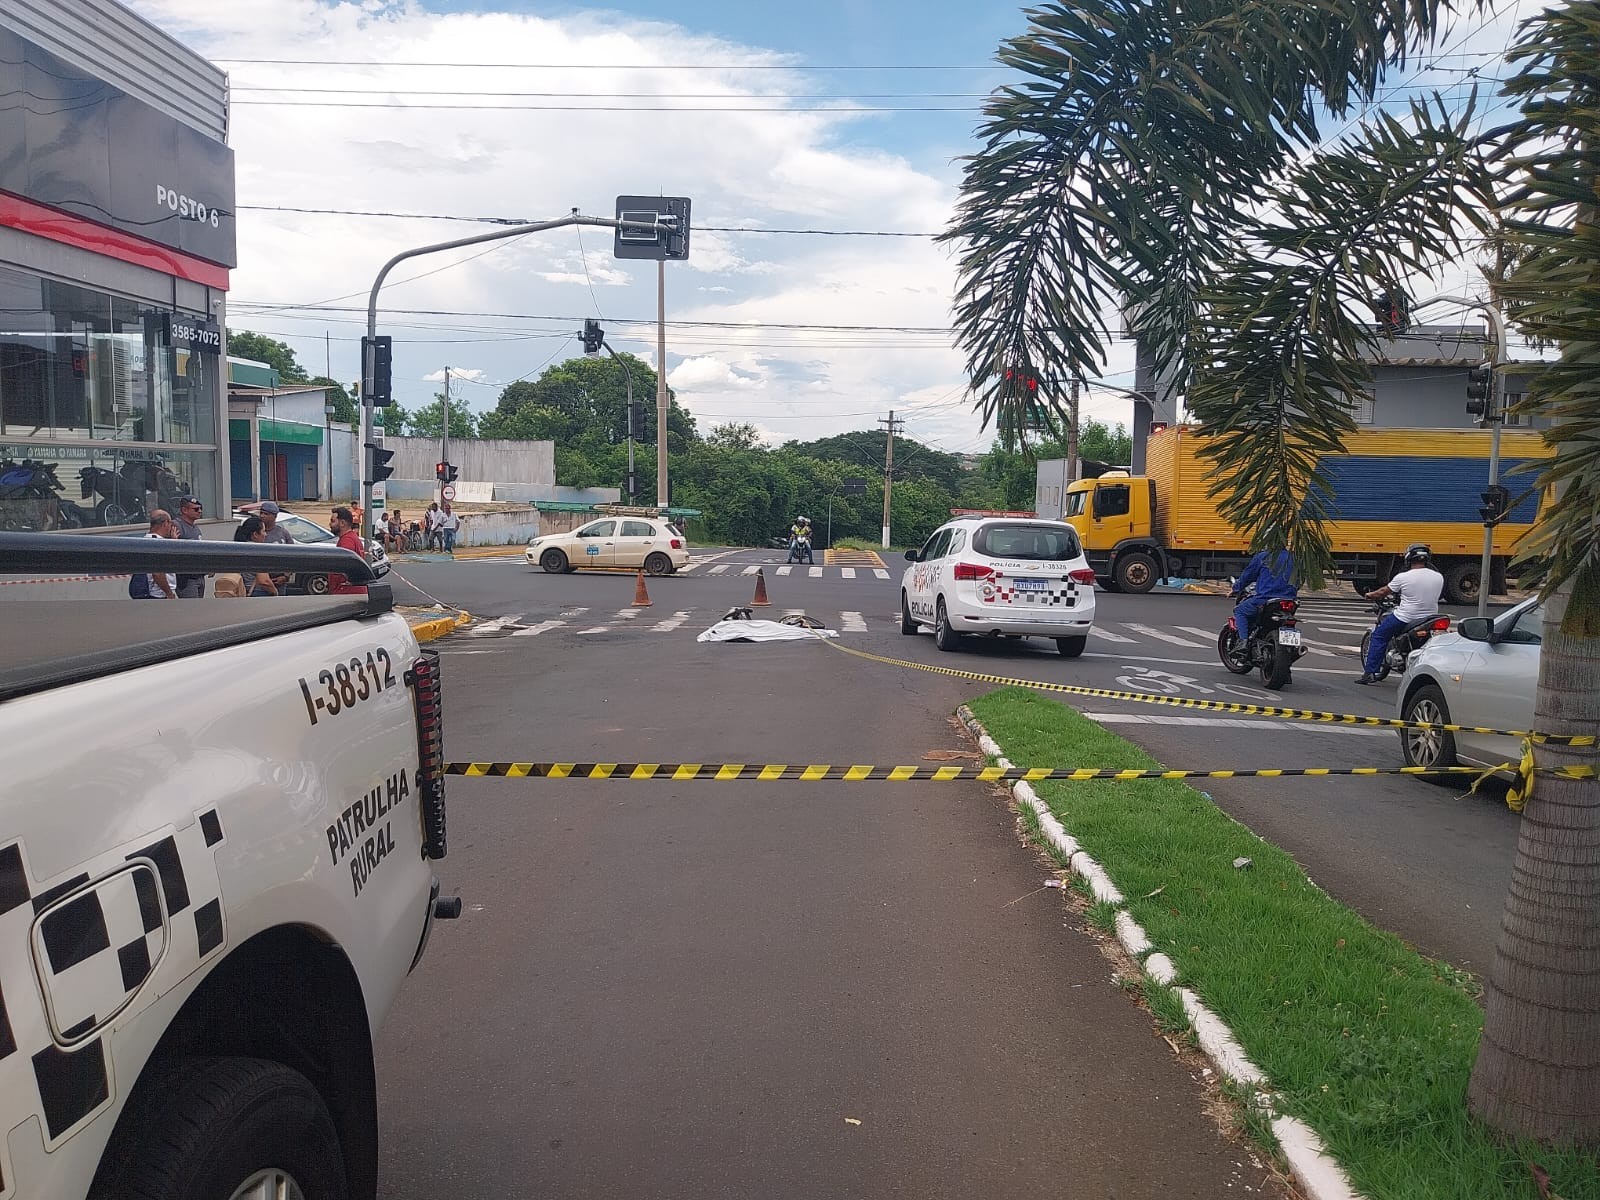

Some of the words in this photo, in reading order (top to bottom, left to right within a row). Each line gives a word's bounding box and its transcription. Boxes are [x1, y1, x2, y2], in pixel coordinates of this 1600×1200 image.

[156, 184, 207, 223] POSTO
[210, 208, 219, 229] 6
[172, 323, 220, 346] 3585-7072
[34, 447, 57, 458] YAMAHA
[911, 597, 935, 618] POLÍCIA
[298, 647, 396, 725] I-38312
[326, 767, 410, 866] PATRULHA
[349, 821, 396, 898] RURAL
